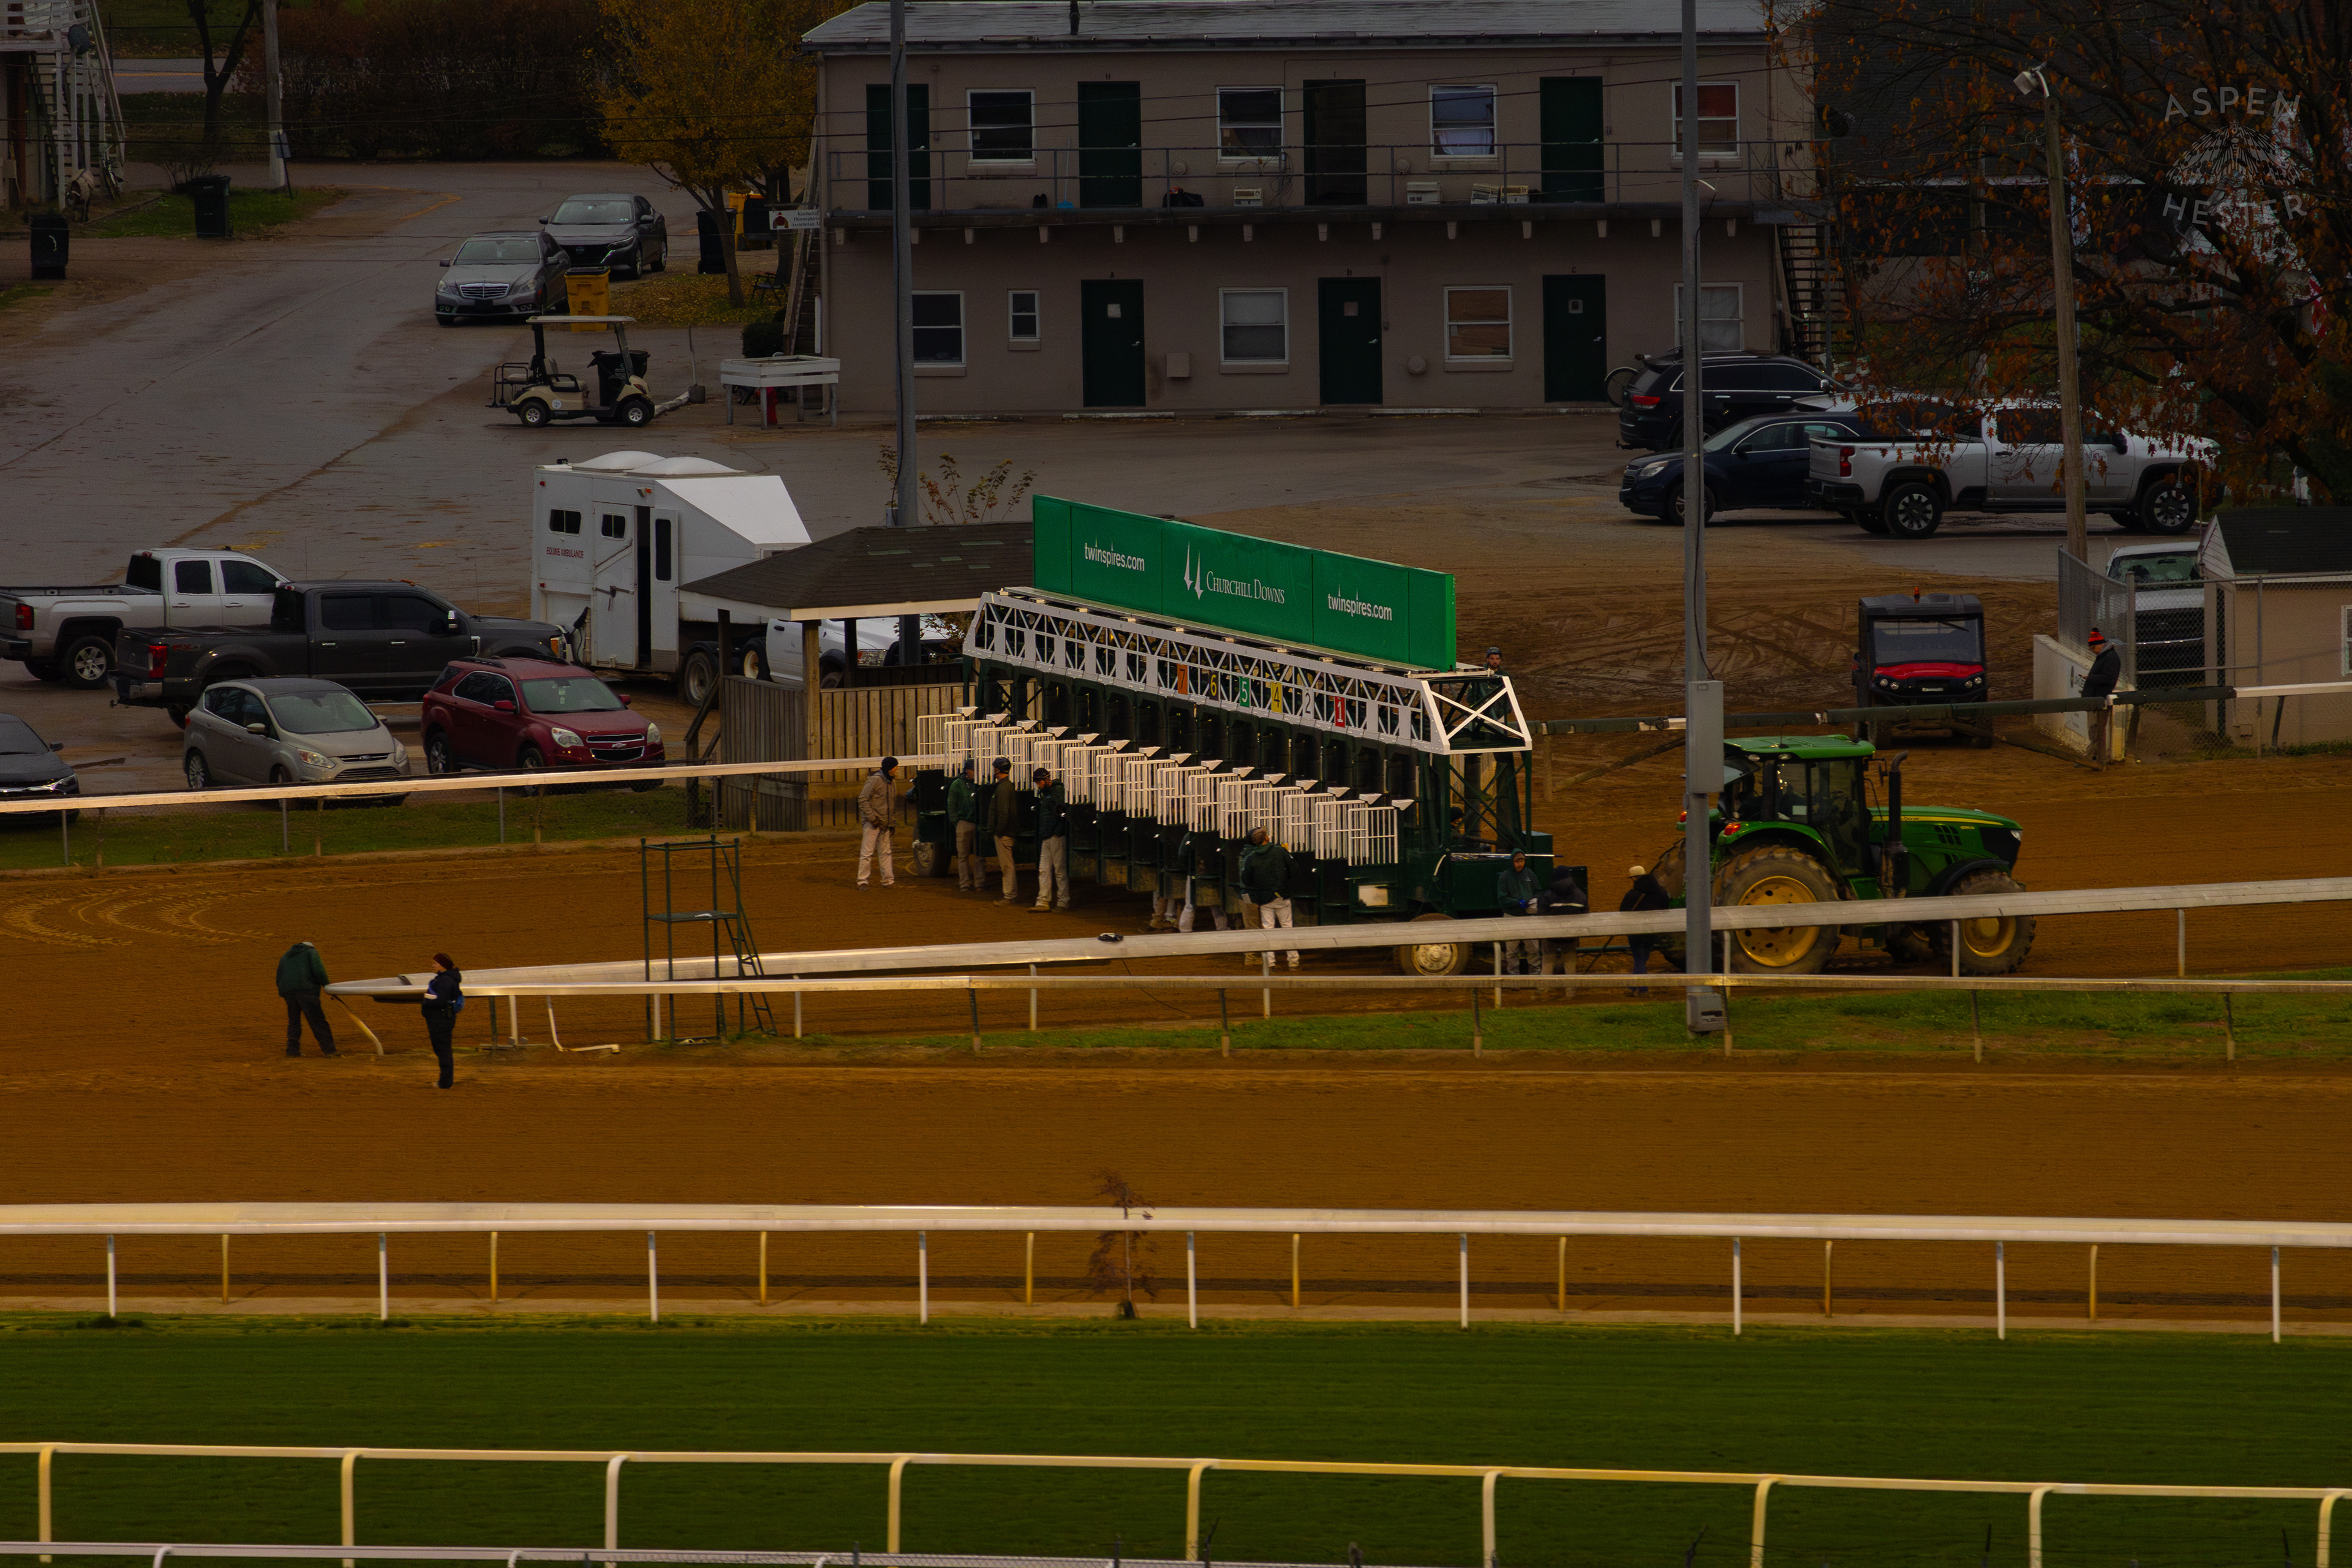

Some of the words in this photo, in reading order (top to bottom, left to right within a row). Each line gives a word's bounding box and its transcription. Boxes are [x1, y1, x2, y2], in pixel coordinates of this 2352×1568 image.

[546, 547, 560, 556] EQUINE
[561, 548, 584, 559] AMBULANCE
[1084, 537, 1145, 571] twinspires.com
[1254, 579, 1285, 604] DOWNS
[1327, 585, 1393, 621] twinspires.com
[1179, 668, 1186, 690] 7
[1210, 674, 1217, 696] 6
[1242, 681, 1248, 703] 5
[1273, 687, 1280, 708] 4
[1305, 692, 1312, 714] 2
[1336, 700, 1344, 723] 1
